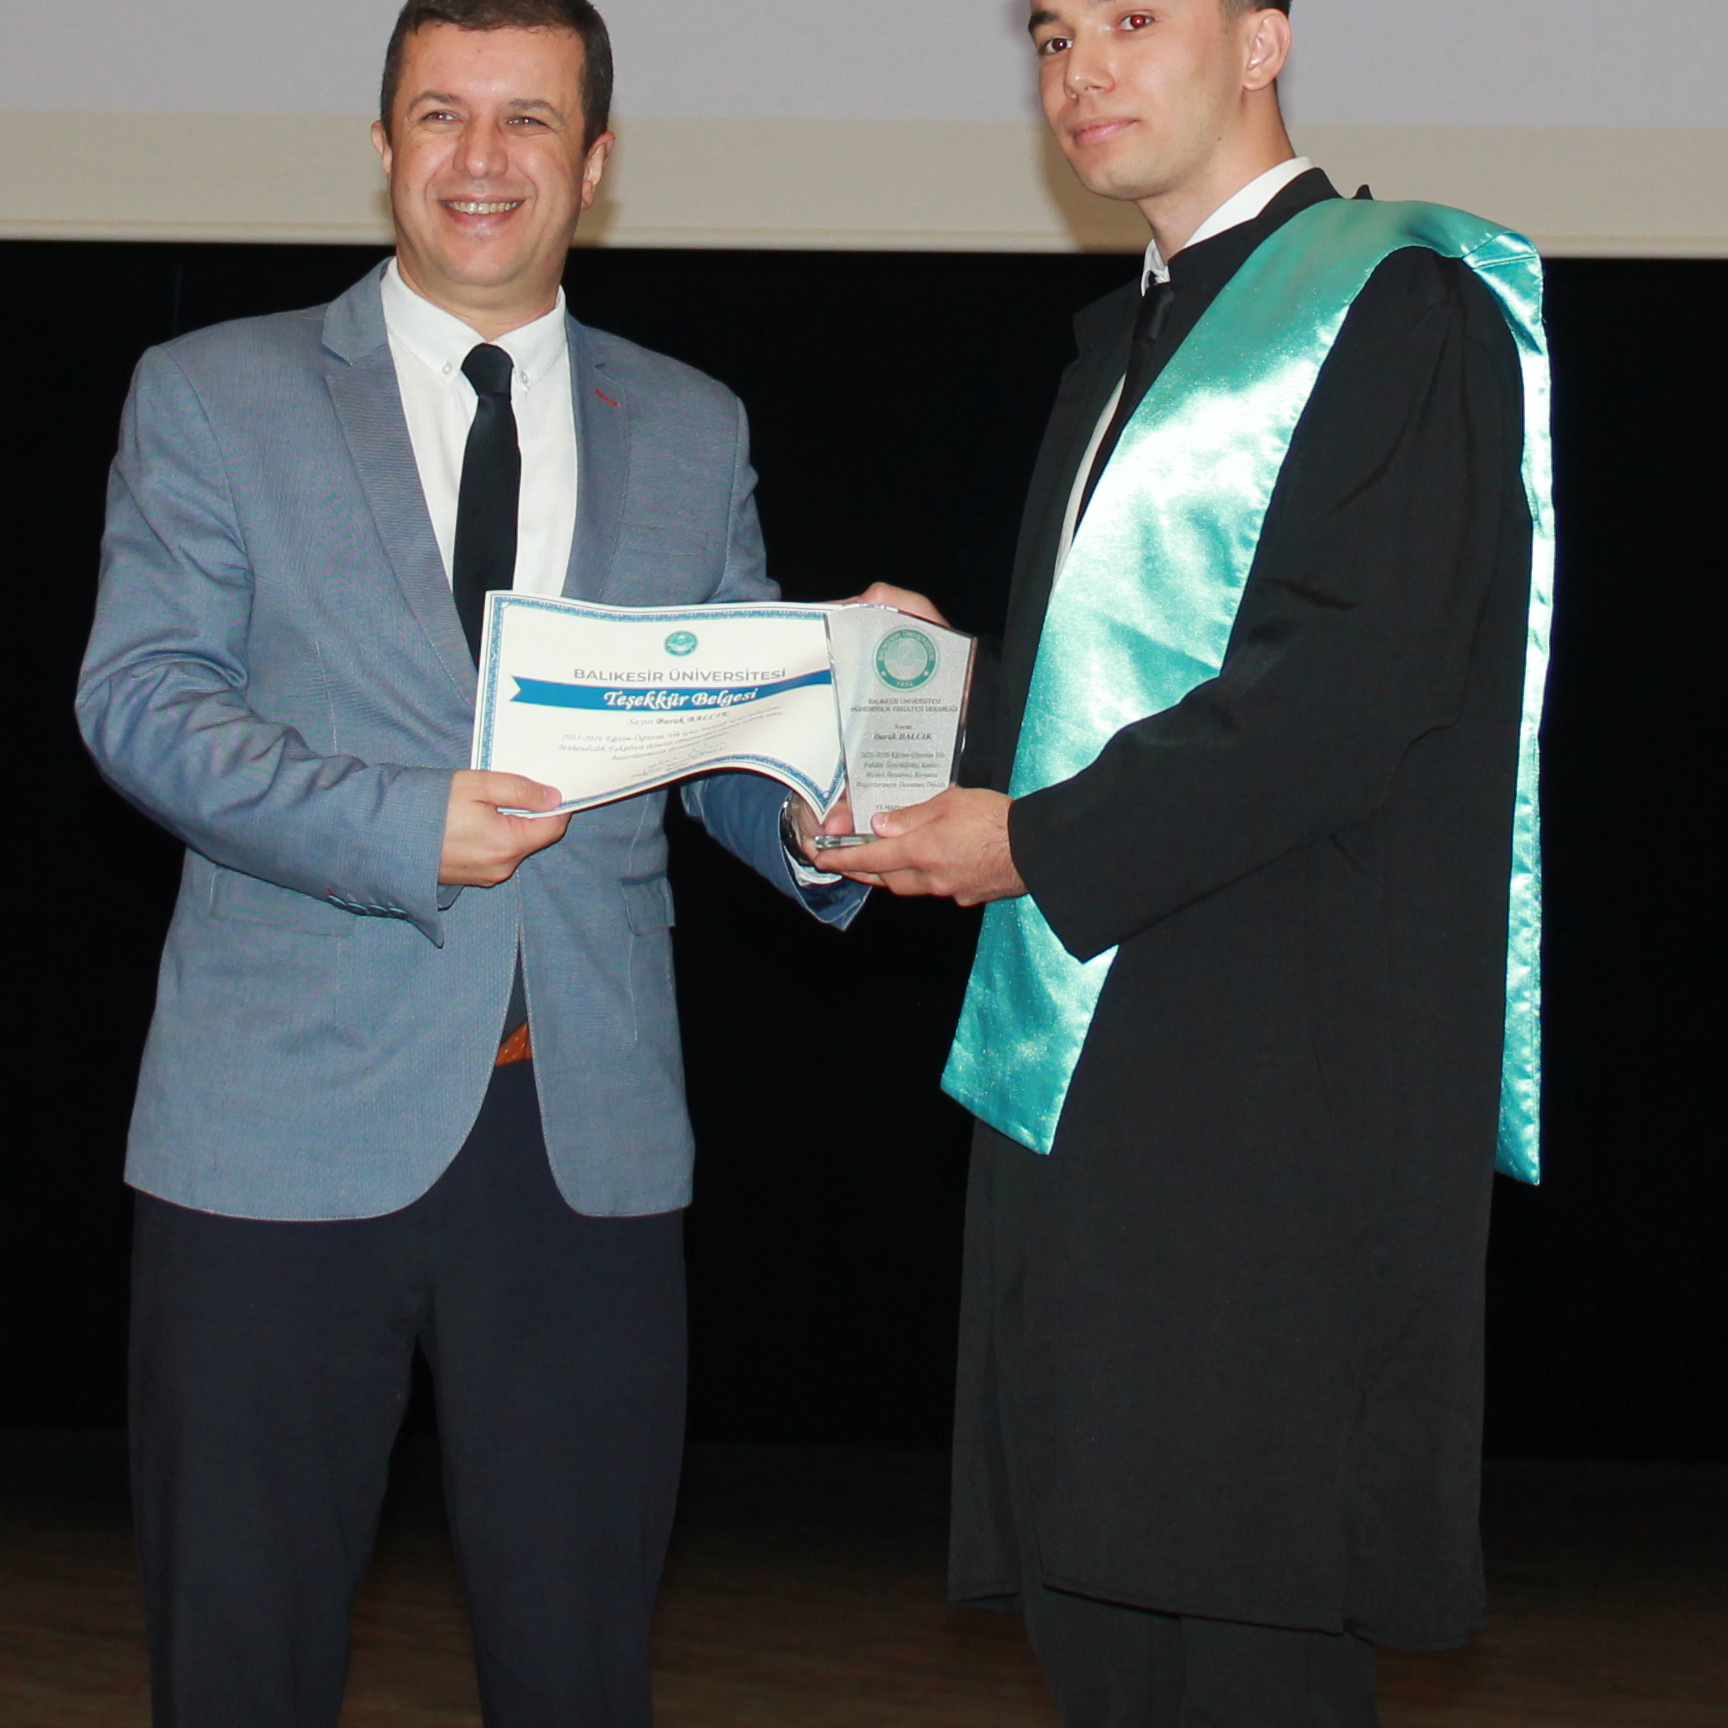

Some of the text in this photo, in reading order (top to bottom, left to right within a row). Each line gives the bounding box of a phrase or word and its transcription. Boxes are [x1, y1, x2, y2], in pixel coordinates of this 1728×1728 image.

[573, 667, 787, 683] BALIKESİR ÜNİVERSİTESİ
[603, 687, 759, 711] Teşekkür Belgesi
